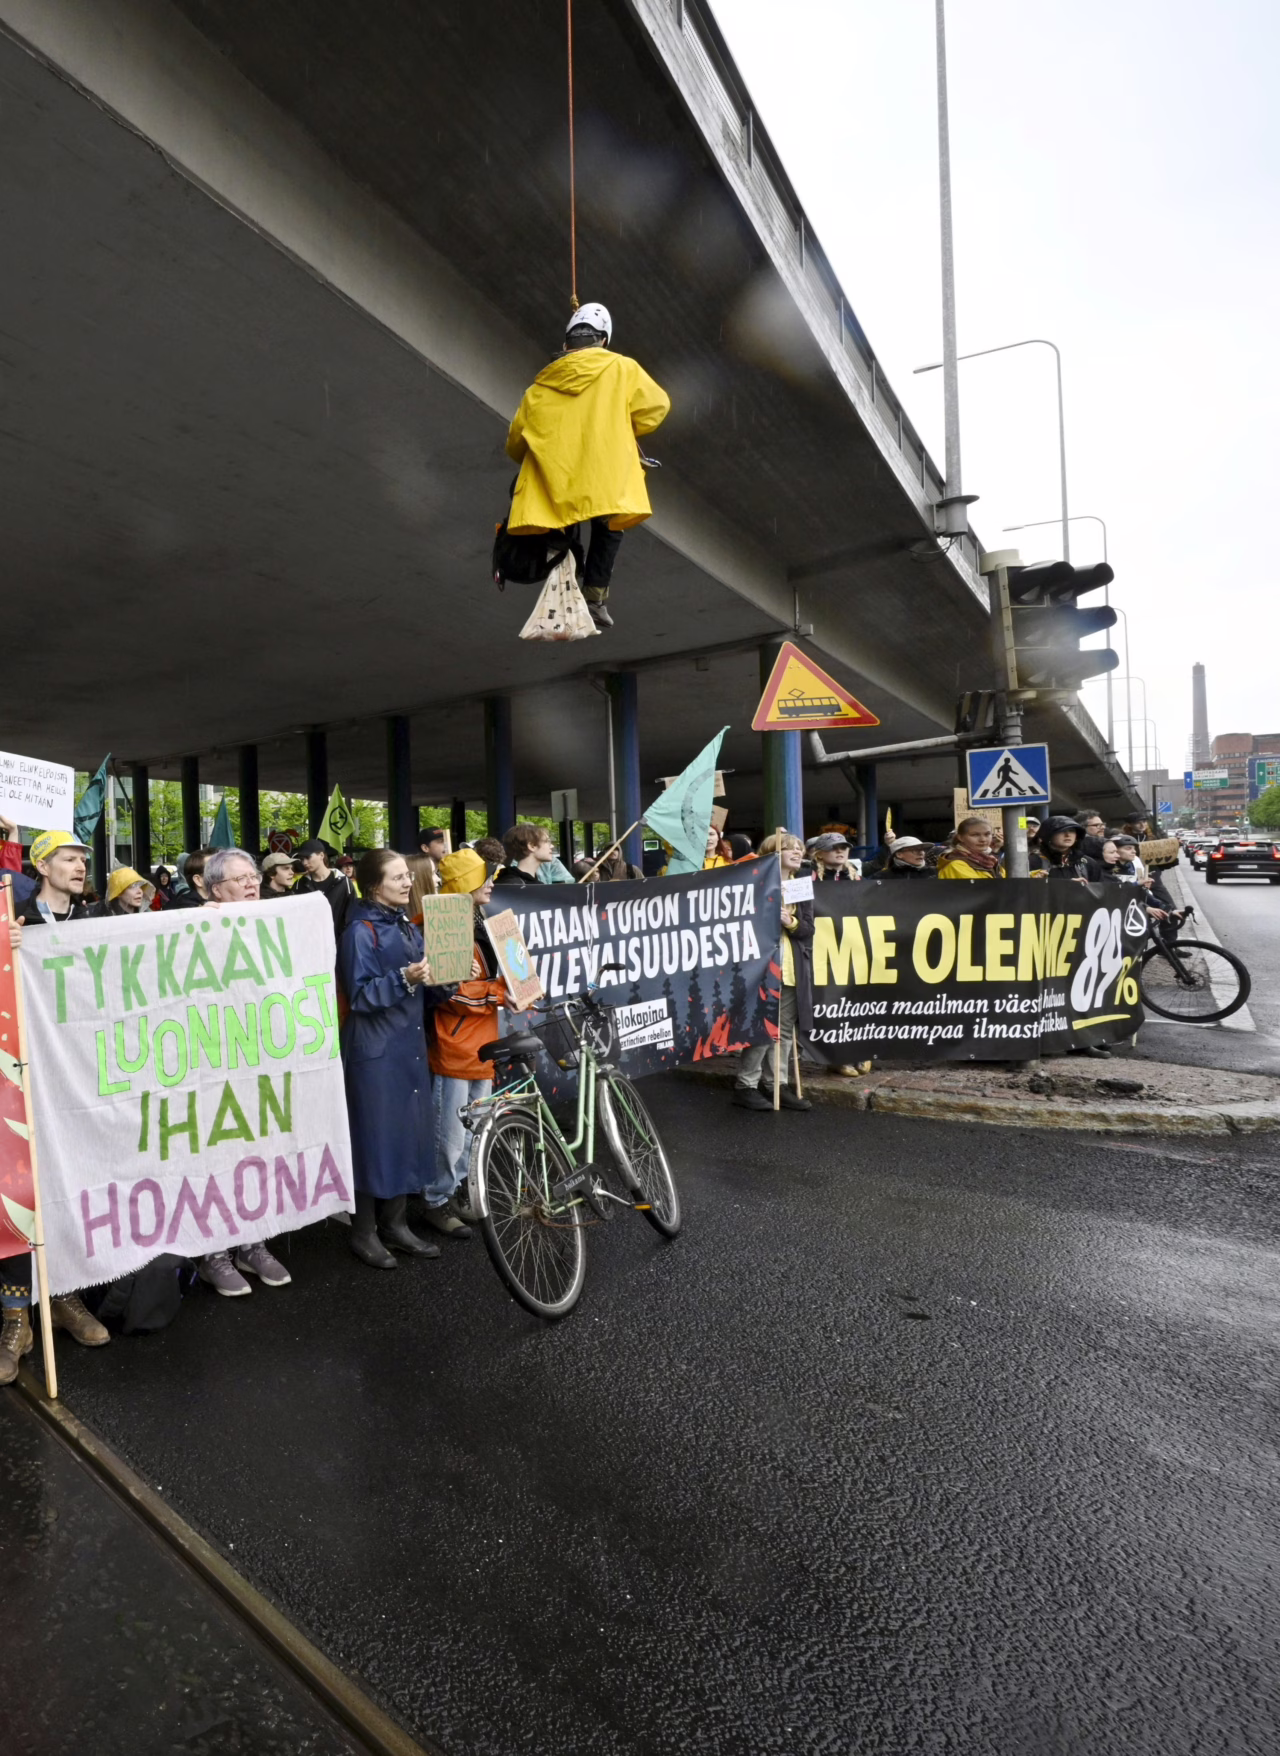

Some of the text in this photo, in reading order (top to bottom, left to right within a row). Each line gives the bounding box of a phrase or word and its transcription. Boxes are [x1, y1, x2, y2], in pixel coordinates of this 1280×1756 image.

[8, 789, 23, 800] OLE
[424, 897, 471, 915] HALLITUS
[514, 903, 600, 950] ATAAN
[605, 892, 680, 936] TUHON
[687, 883, 756, 924] TUISTA
[427, 915, 467, 932] KANNA
[425, 932, 471, 951] VASTUU
[812, 915, 898, 987] ME
[42, 916, 294, 1024] TYKKÄÄN
[531, 919, 761, 998] ULEVAISUUDESTA
[616, 1005, 664, 1029] elokapina
[812, 996, 887, 1019] valtaosa
[891, 993, 989, 1016] maailman
[620, 1028, 672, 1048] extinction rebellion
[808, 1020, 964, 1046] vaikuttavampaa
[136, 1071, 293, 1162] IHAN
[79, 1141, 351, 1259] HOMONA
